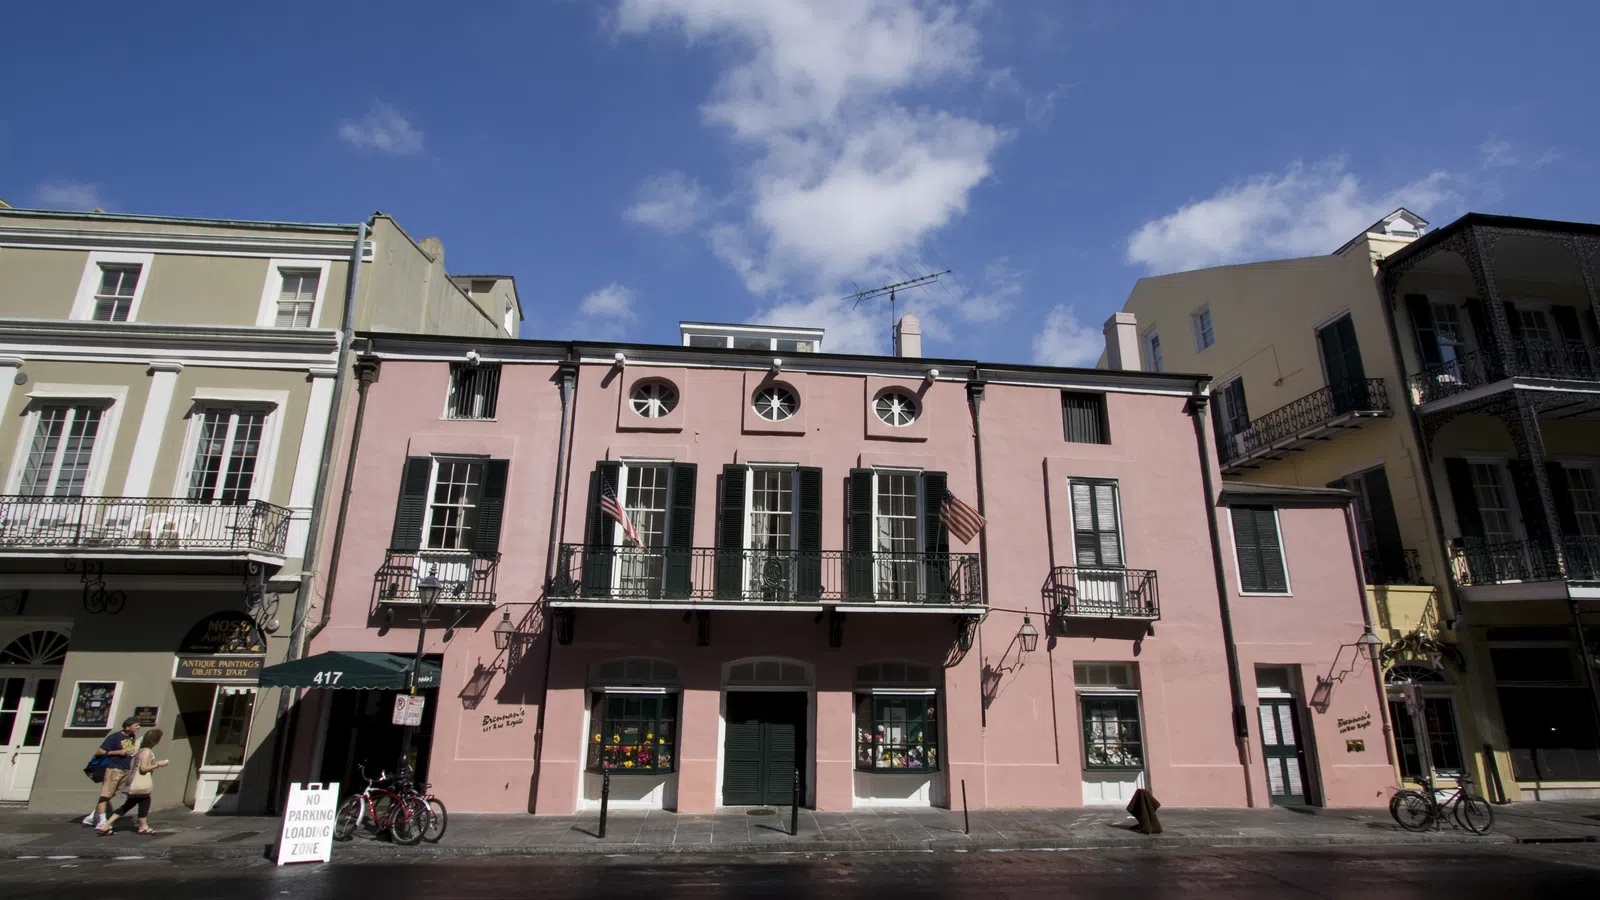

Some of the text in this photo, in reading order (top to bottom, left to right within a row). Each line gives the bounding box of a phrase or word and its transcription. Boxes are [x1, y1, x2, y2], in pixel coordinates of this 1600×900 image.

[208, 619, 252, 632] MOSS
[182, 660, 260, 668] ANTIQUE PAINTINGS
[192, 668, 248, 676] OBJETS D'ART
[313, 671, 343, 684] 417
[306, 794, 321, 806] NO
[288, 809, 334, 822] PARKING
[284, 826, 330, 839] LOADING
[291, 842, 320, 856] ZONE
